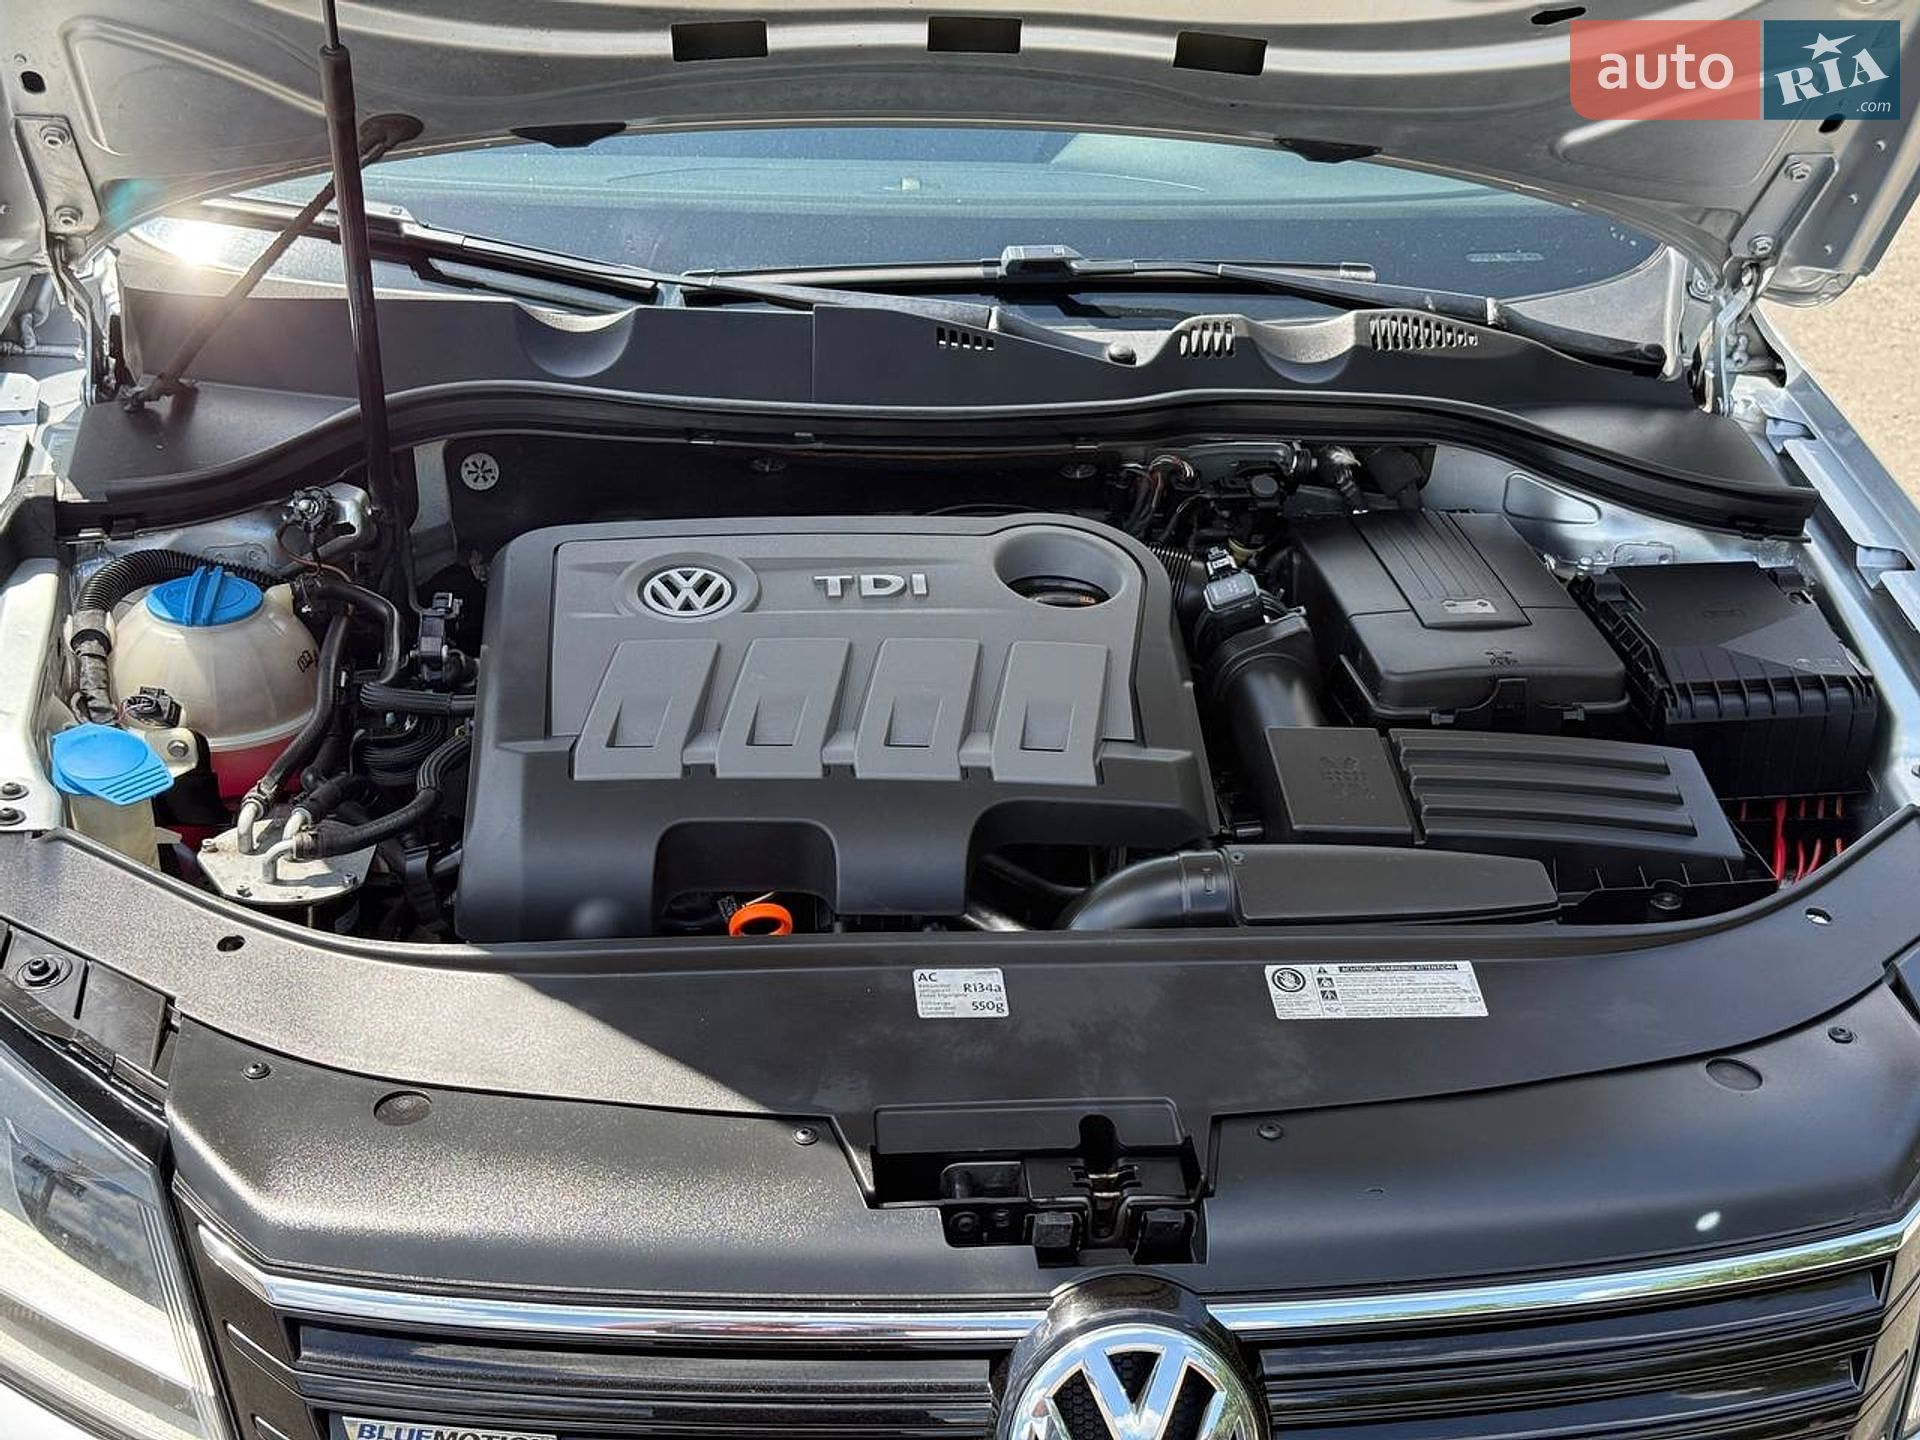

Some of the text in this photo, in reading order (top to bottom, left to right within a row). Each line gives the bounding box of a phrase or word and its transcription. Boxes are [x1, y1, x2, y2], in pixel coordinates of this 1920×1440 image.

[814, 573, 928, 598] TDI
[918, 972, 937, 982] AC
[963, 982, 1002, 993] R134a
[972, 1001, 1004, 1014] 550g
